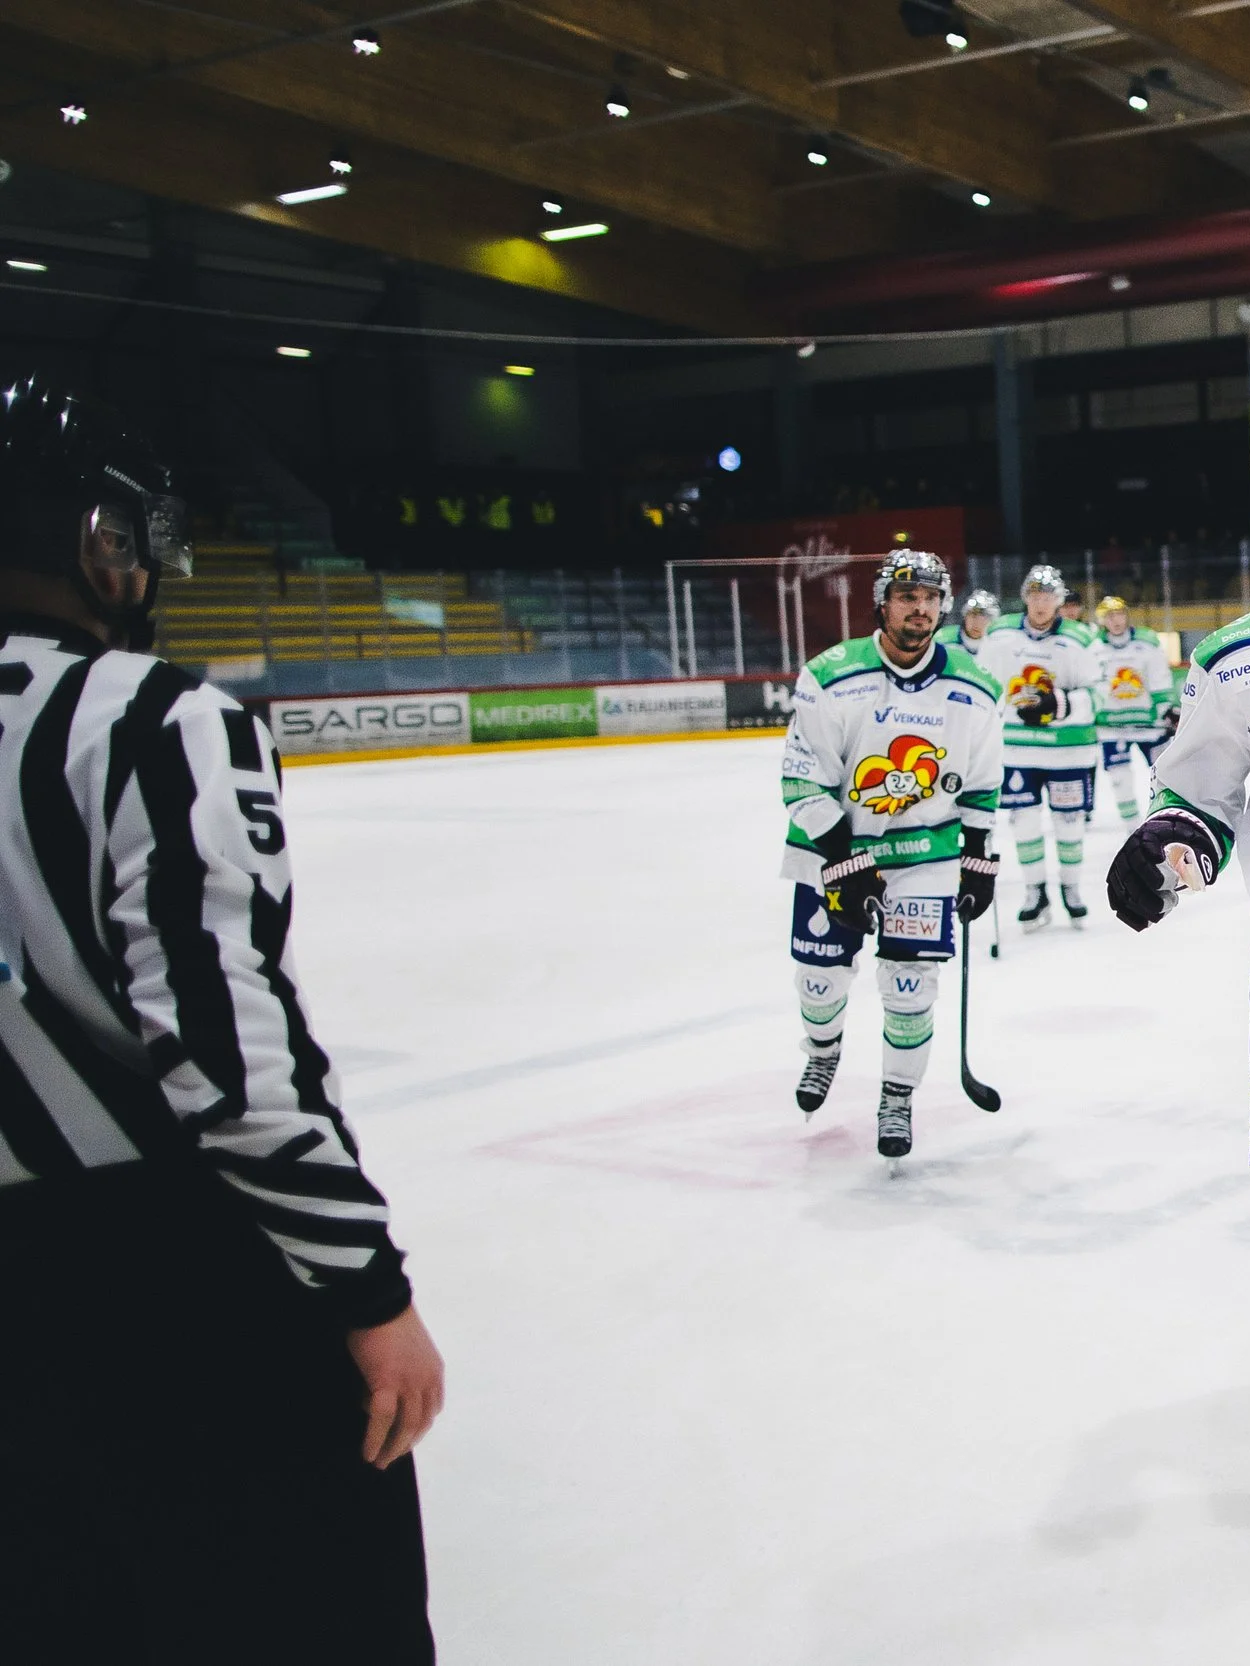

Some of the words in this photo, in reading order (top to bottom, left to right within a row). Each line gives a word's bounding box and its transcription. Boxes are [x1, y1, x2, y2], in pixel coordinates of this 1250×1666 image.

[281, 702, 463, 736] SARGO
[894, 713, 943, 726] VEIKKAUS
[895, 838, 931, 854] KING
[885, 918, 937, 935] CREW
[792, 936, 844, 957] INFUEL
[896, 977, 920, 993] W
